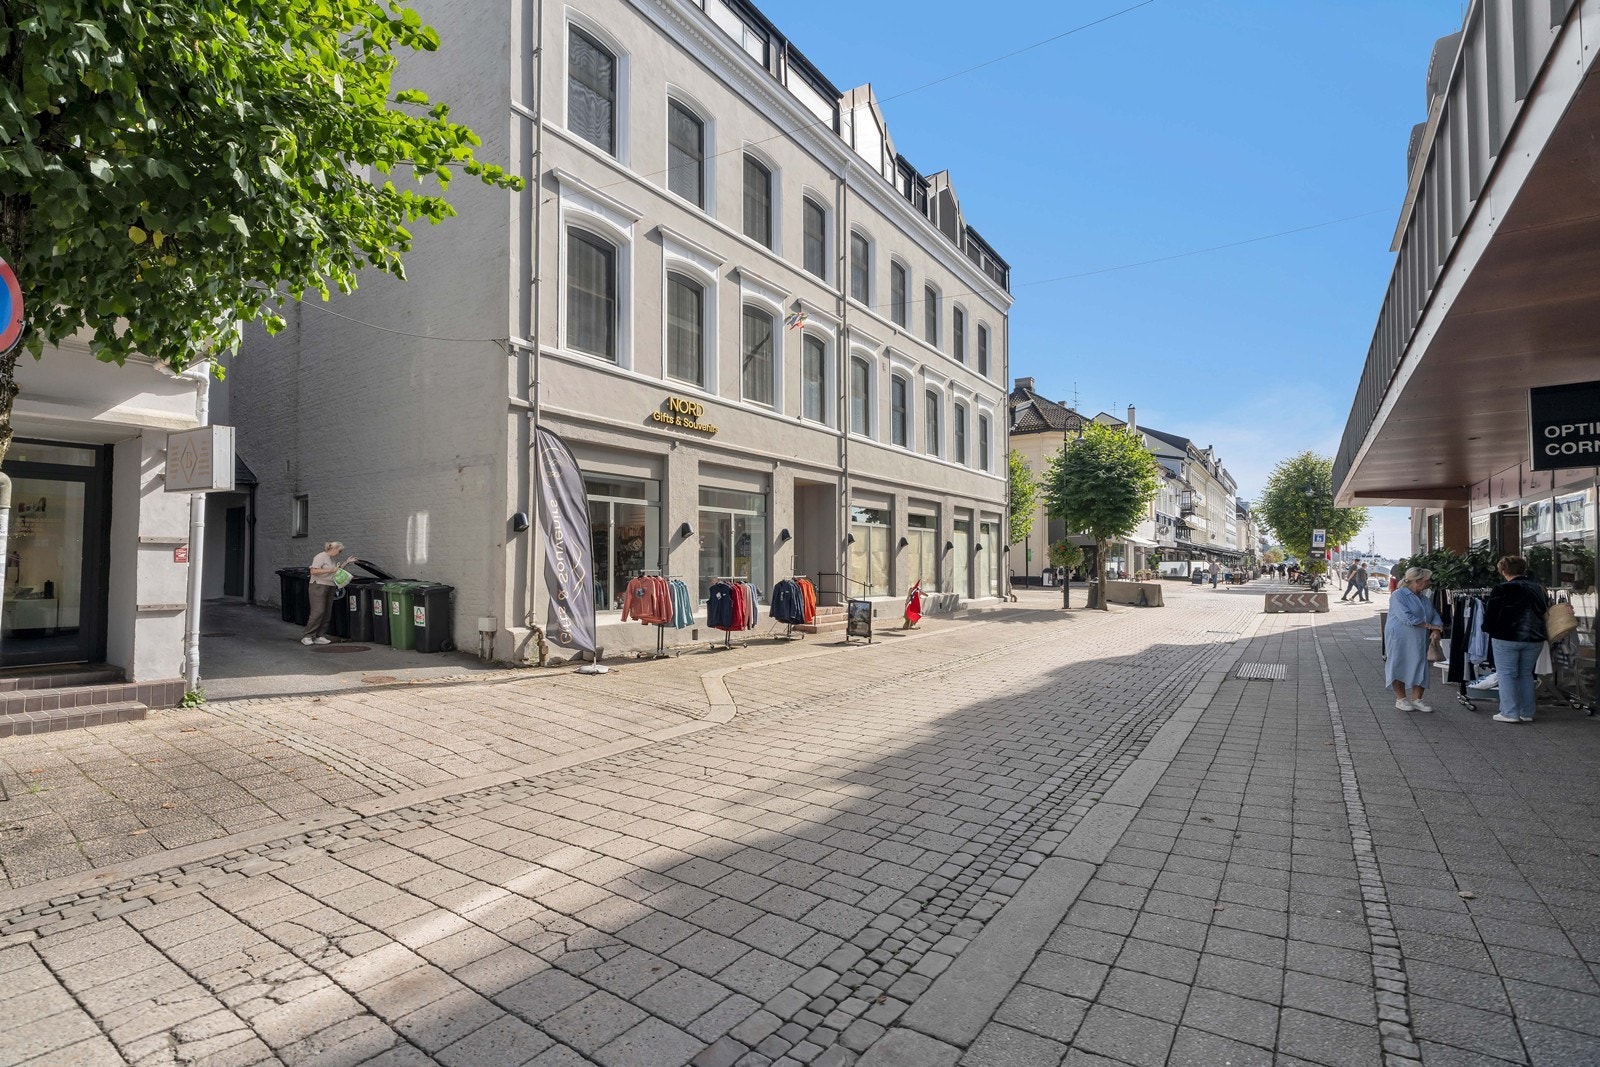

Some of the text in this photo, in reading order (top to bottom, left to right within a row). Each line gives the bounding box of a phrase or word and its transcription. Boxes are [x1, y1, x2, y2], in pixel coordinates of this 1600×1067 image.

[668, 396, 704, 417] NORD
[652, 411, 674, 424] Gifts
[675, 416, 682, 426] &
[1544, 422, 1600, 438] OPTI
